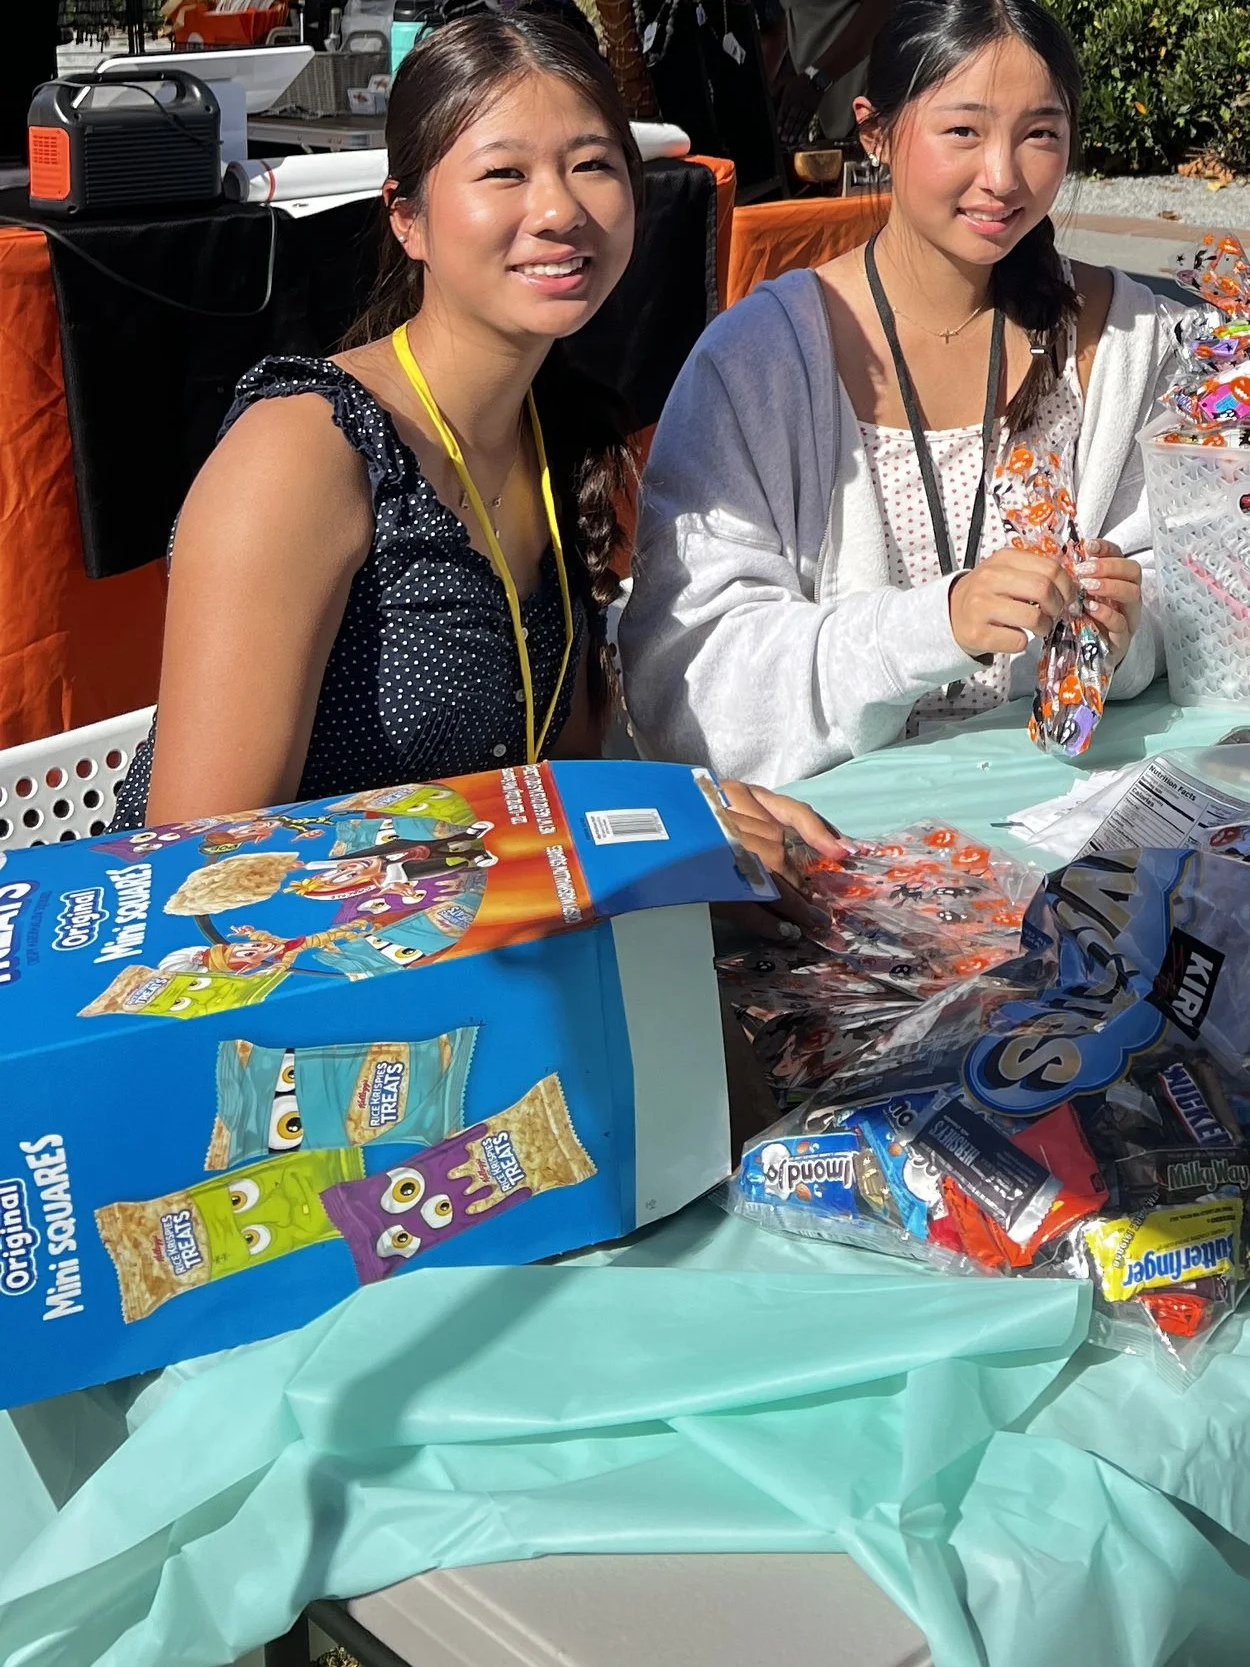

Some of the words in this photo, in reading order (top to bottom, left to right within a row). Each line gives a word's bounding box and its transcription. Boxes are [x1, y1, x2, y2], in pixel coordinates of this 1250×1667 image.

[1132, 787, 1155, 808] Calories
[1148, 765, 1178, 789] Nutrition
[1177, 785, 1197, 802] Facts
[105, 863, 153, 924] SQUARES
[61, 890, 101, 947] Original
[93, 922, 148, 964] Mini
[369, 1062, 388, 1105] KRISPIES
[381, 1063, 404, 1124] TREATS
[370, 1105, 381, 1126] RICE
[482, 1137, 502, 1176] KRISPIES
[493, 1132, 525, 1186] TREATS
[929, 1120, 981, 1167] HERSHEY'S
[19, 1134, 77, 1256] SQUARES
[496, 1173, 512, 1192] RICE
[787, 1158, 856, 1189] lmond
[0, 1184, 33, 1289] Original
[162, 1215, 180, 1256] KRISPIES
[174, 1210, 202, 1269] TREATS
[171, 1253, 186, 1274] RICE
[42, 1258, 84, 1321] Mini
